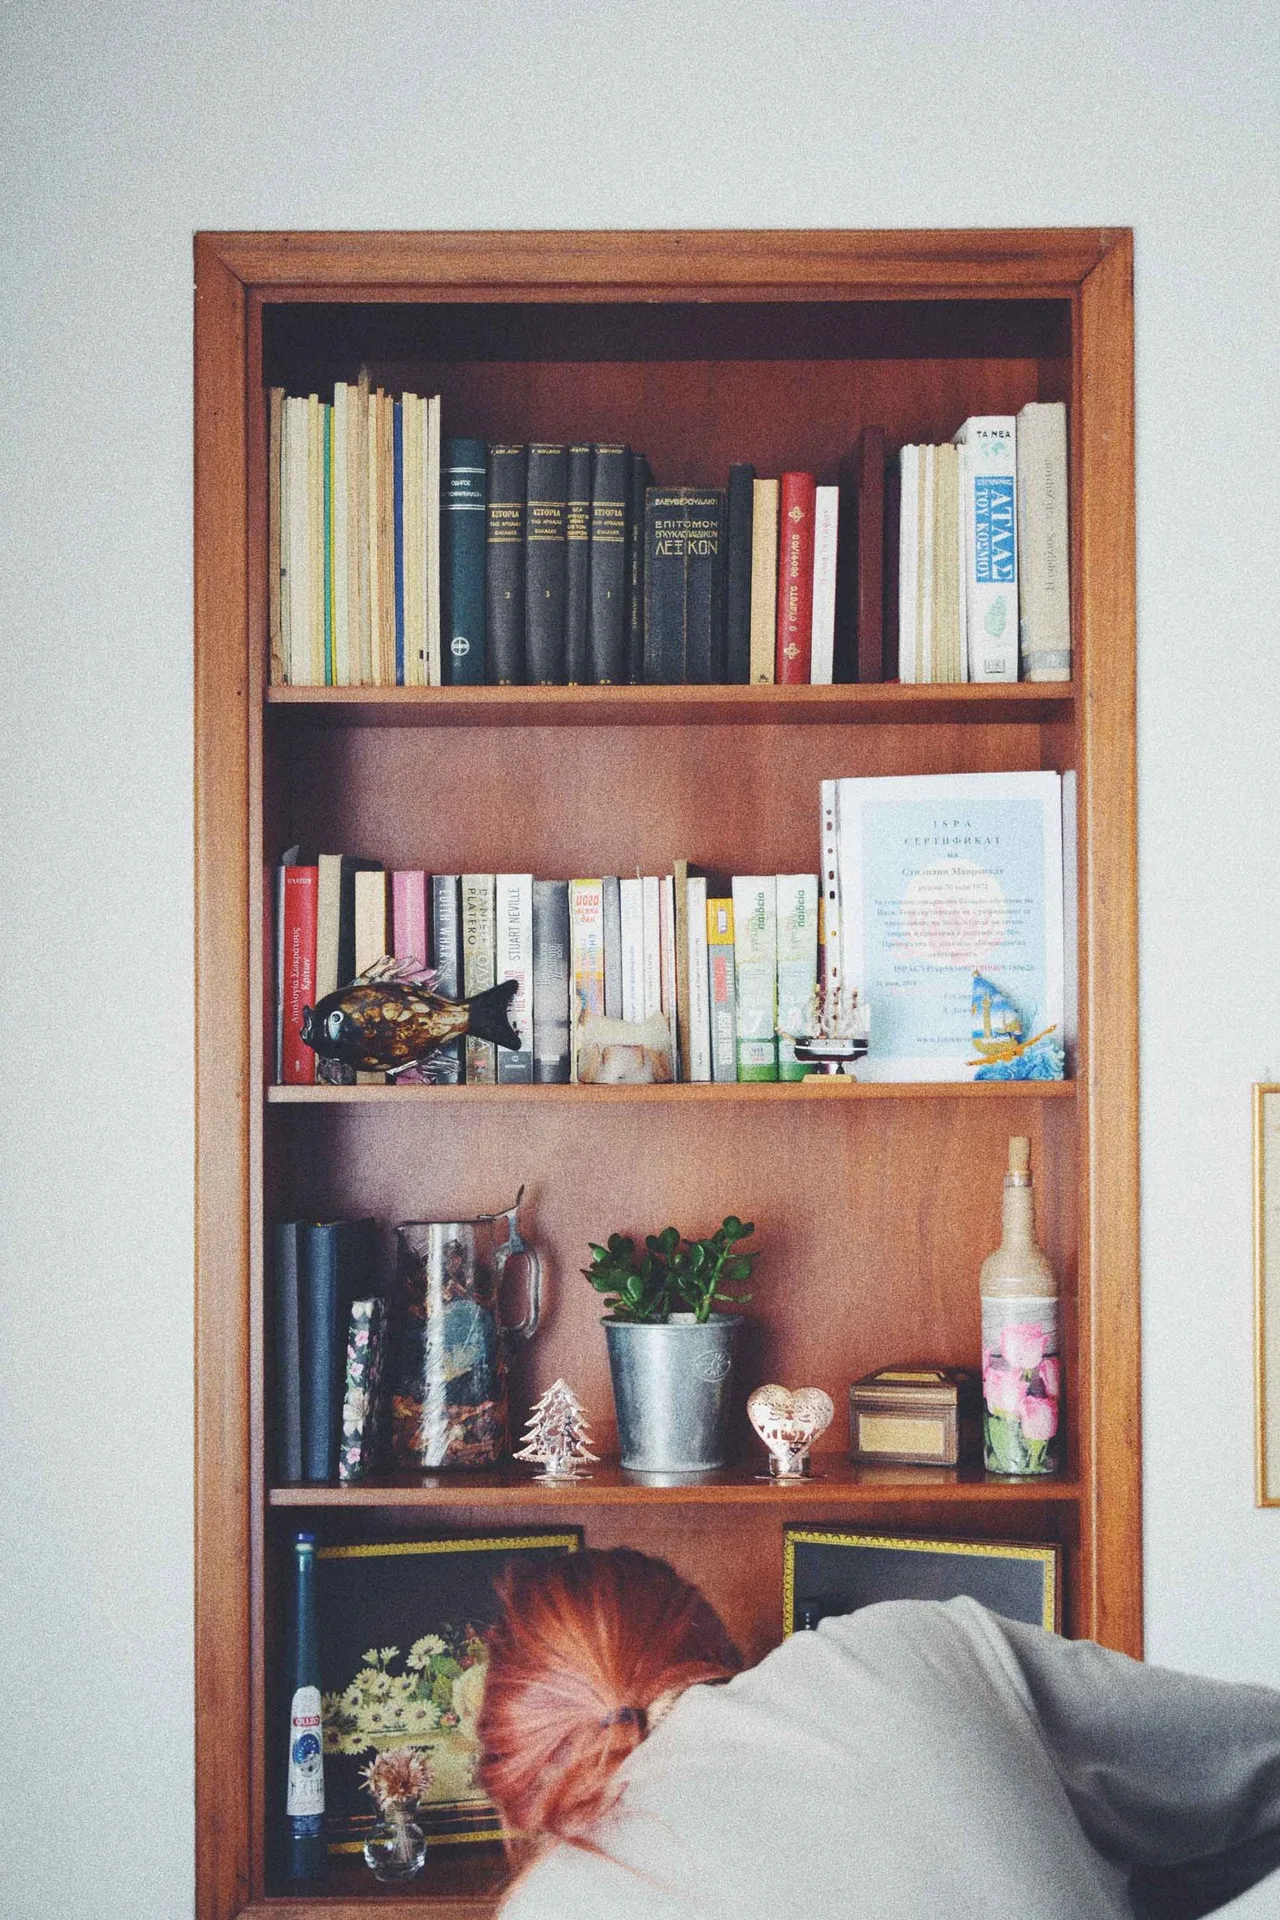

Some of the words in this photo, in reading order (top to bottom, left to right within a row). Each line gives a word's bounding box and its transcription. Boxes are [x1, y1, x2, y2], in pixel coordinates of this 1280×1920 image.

[976, 430, 988, 438] ΤΑ
[990, 430, 1012, 438] ΝΕΑ
[976, 488, 988, 518] ΤΟΥ
[491, 510, 520, 518] ΙΣΤΟΡΙΑ
[533, 508, 561, 517] ΙΣΤΟΡΙΑ
[594, 508, 623, 517] ΙΣΤΟΡΙΑ
[655, 520, 718, 529] ΕΠΙΤΟΜΟΝ
[991, 489, 1013, 583] ΑΤΛΑΣ
[976, 523, 989, 578] ΚΟΣΜΟΥ
[504, 591, 511, 599] 2
[545, 590, 551, 598] 3
[903, 836, 1001, 846] СЕРТИФИКАТ
[508, 887, 521, 923] NEVILLE
[467, 887, 477, 946] PLATERO
[508, 926, 521, 961] STUART
[290, 927, 302, 978] Σωκράτους
